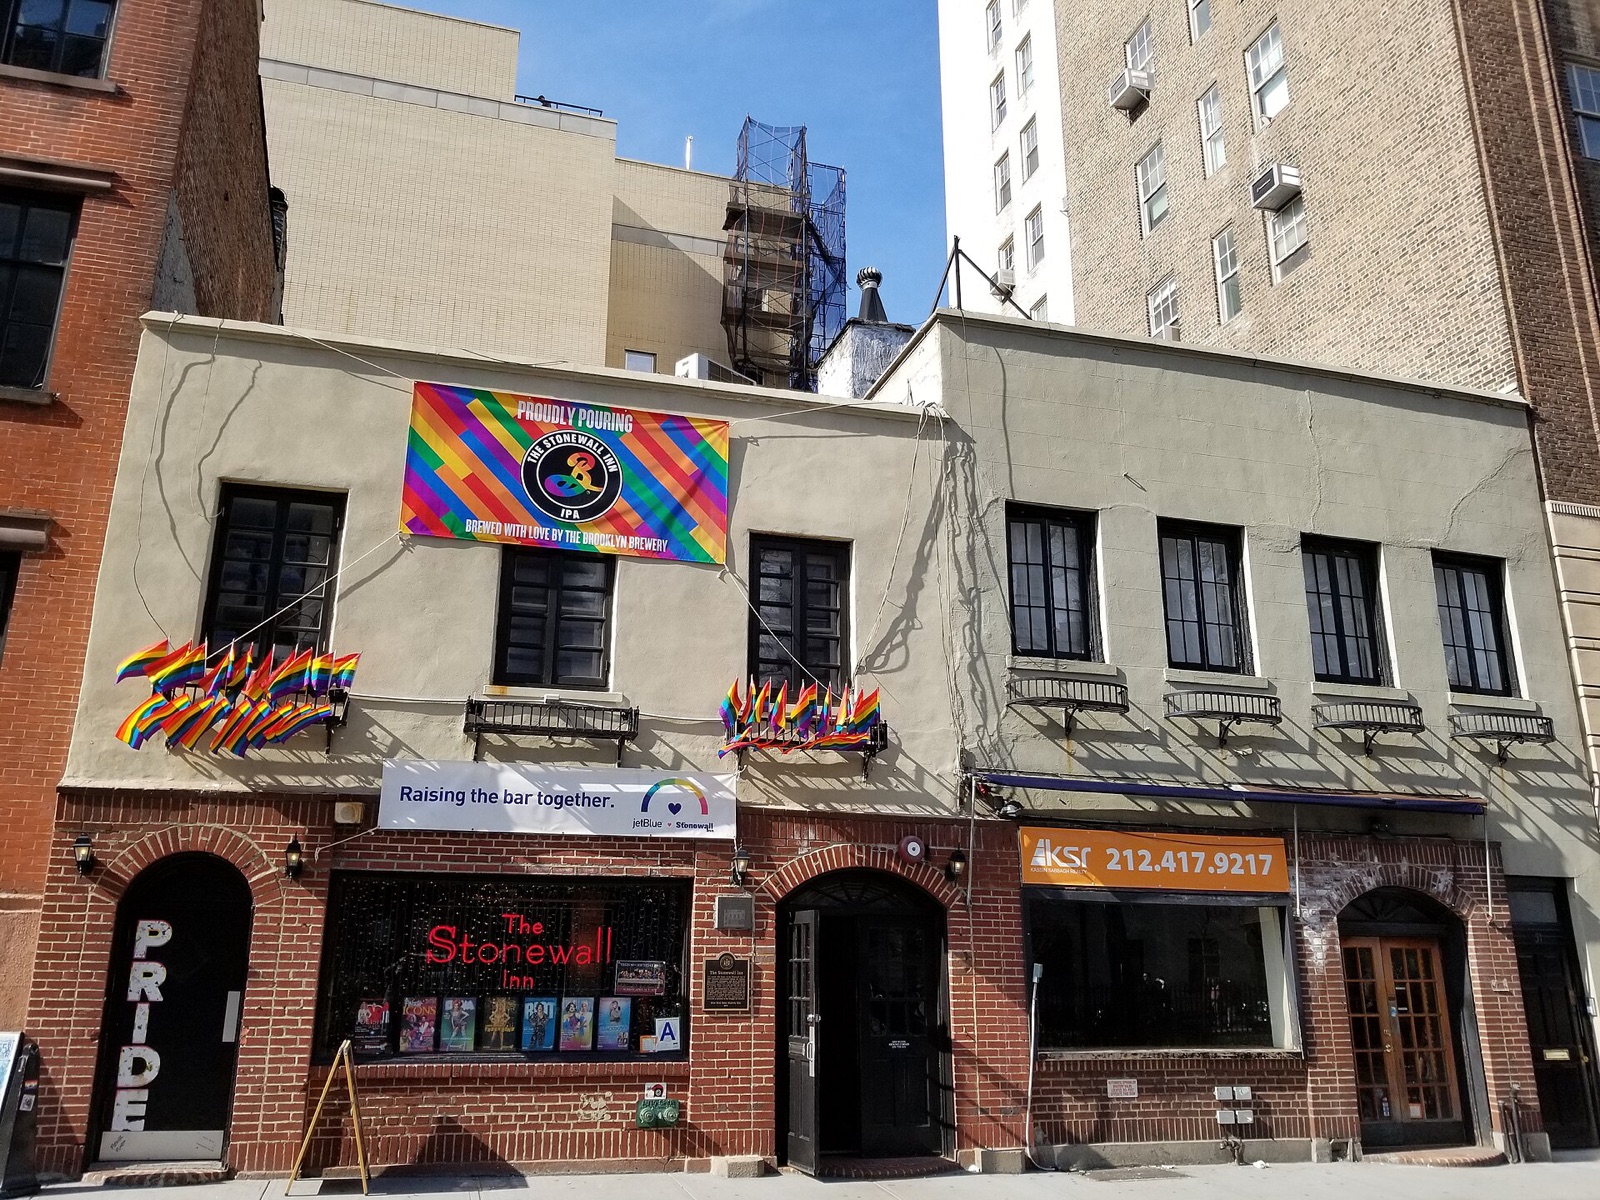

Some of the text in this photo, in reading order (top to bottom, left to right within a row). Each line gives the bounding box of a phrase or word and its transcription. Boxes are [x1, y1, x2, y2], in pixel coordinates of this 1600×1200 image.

[517, 400, 634, 433] PROUDLY POURING
[527, 433, 618, 473] THE STONEWALL INN
[560, 508, 580, 519] IPA
[465, 519, 668, 553] BREWED WITH LOVE BY THE BROOKLYN BREWERY
[400, 785, 614, 810] Raising the bar together.
[632, 818, 714, 830] jetBlue Stonewall
[1106, 847, 1272, 875] 212.417.9217
[502, 913, 543, 935] The
[425, 925, 612, 965] Stonewall
[503, 968, 534, 989] Inn
[402, 1005, 436, 1015] ICONS
[111, 919, 173, 1132] PRIDE
[659, 1021, 676, 1042] A
